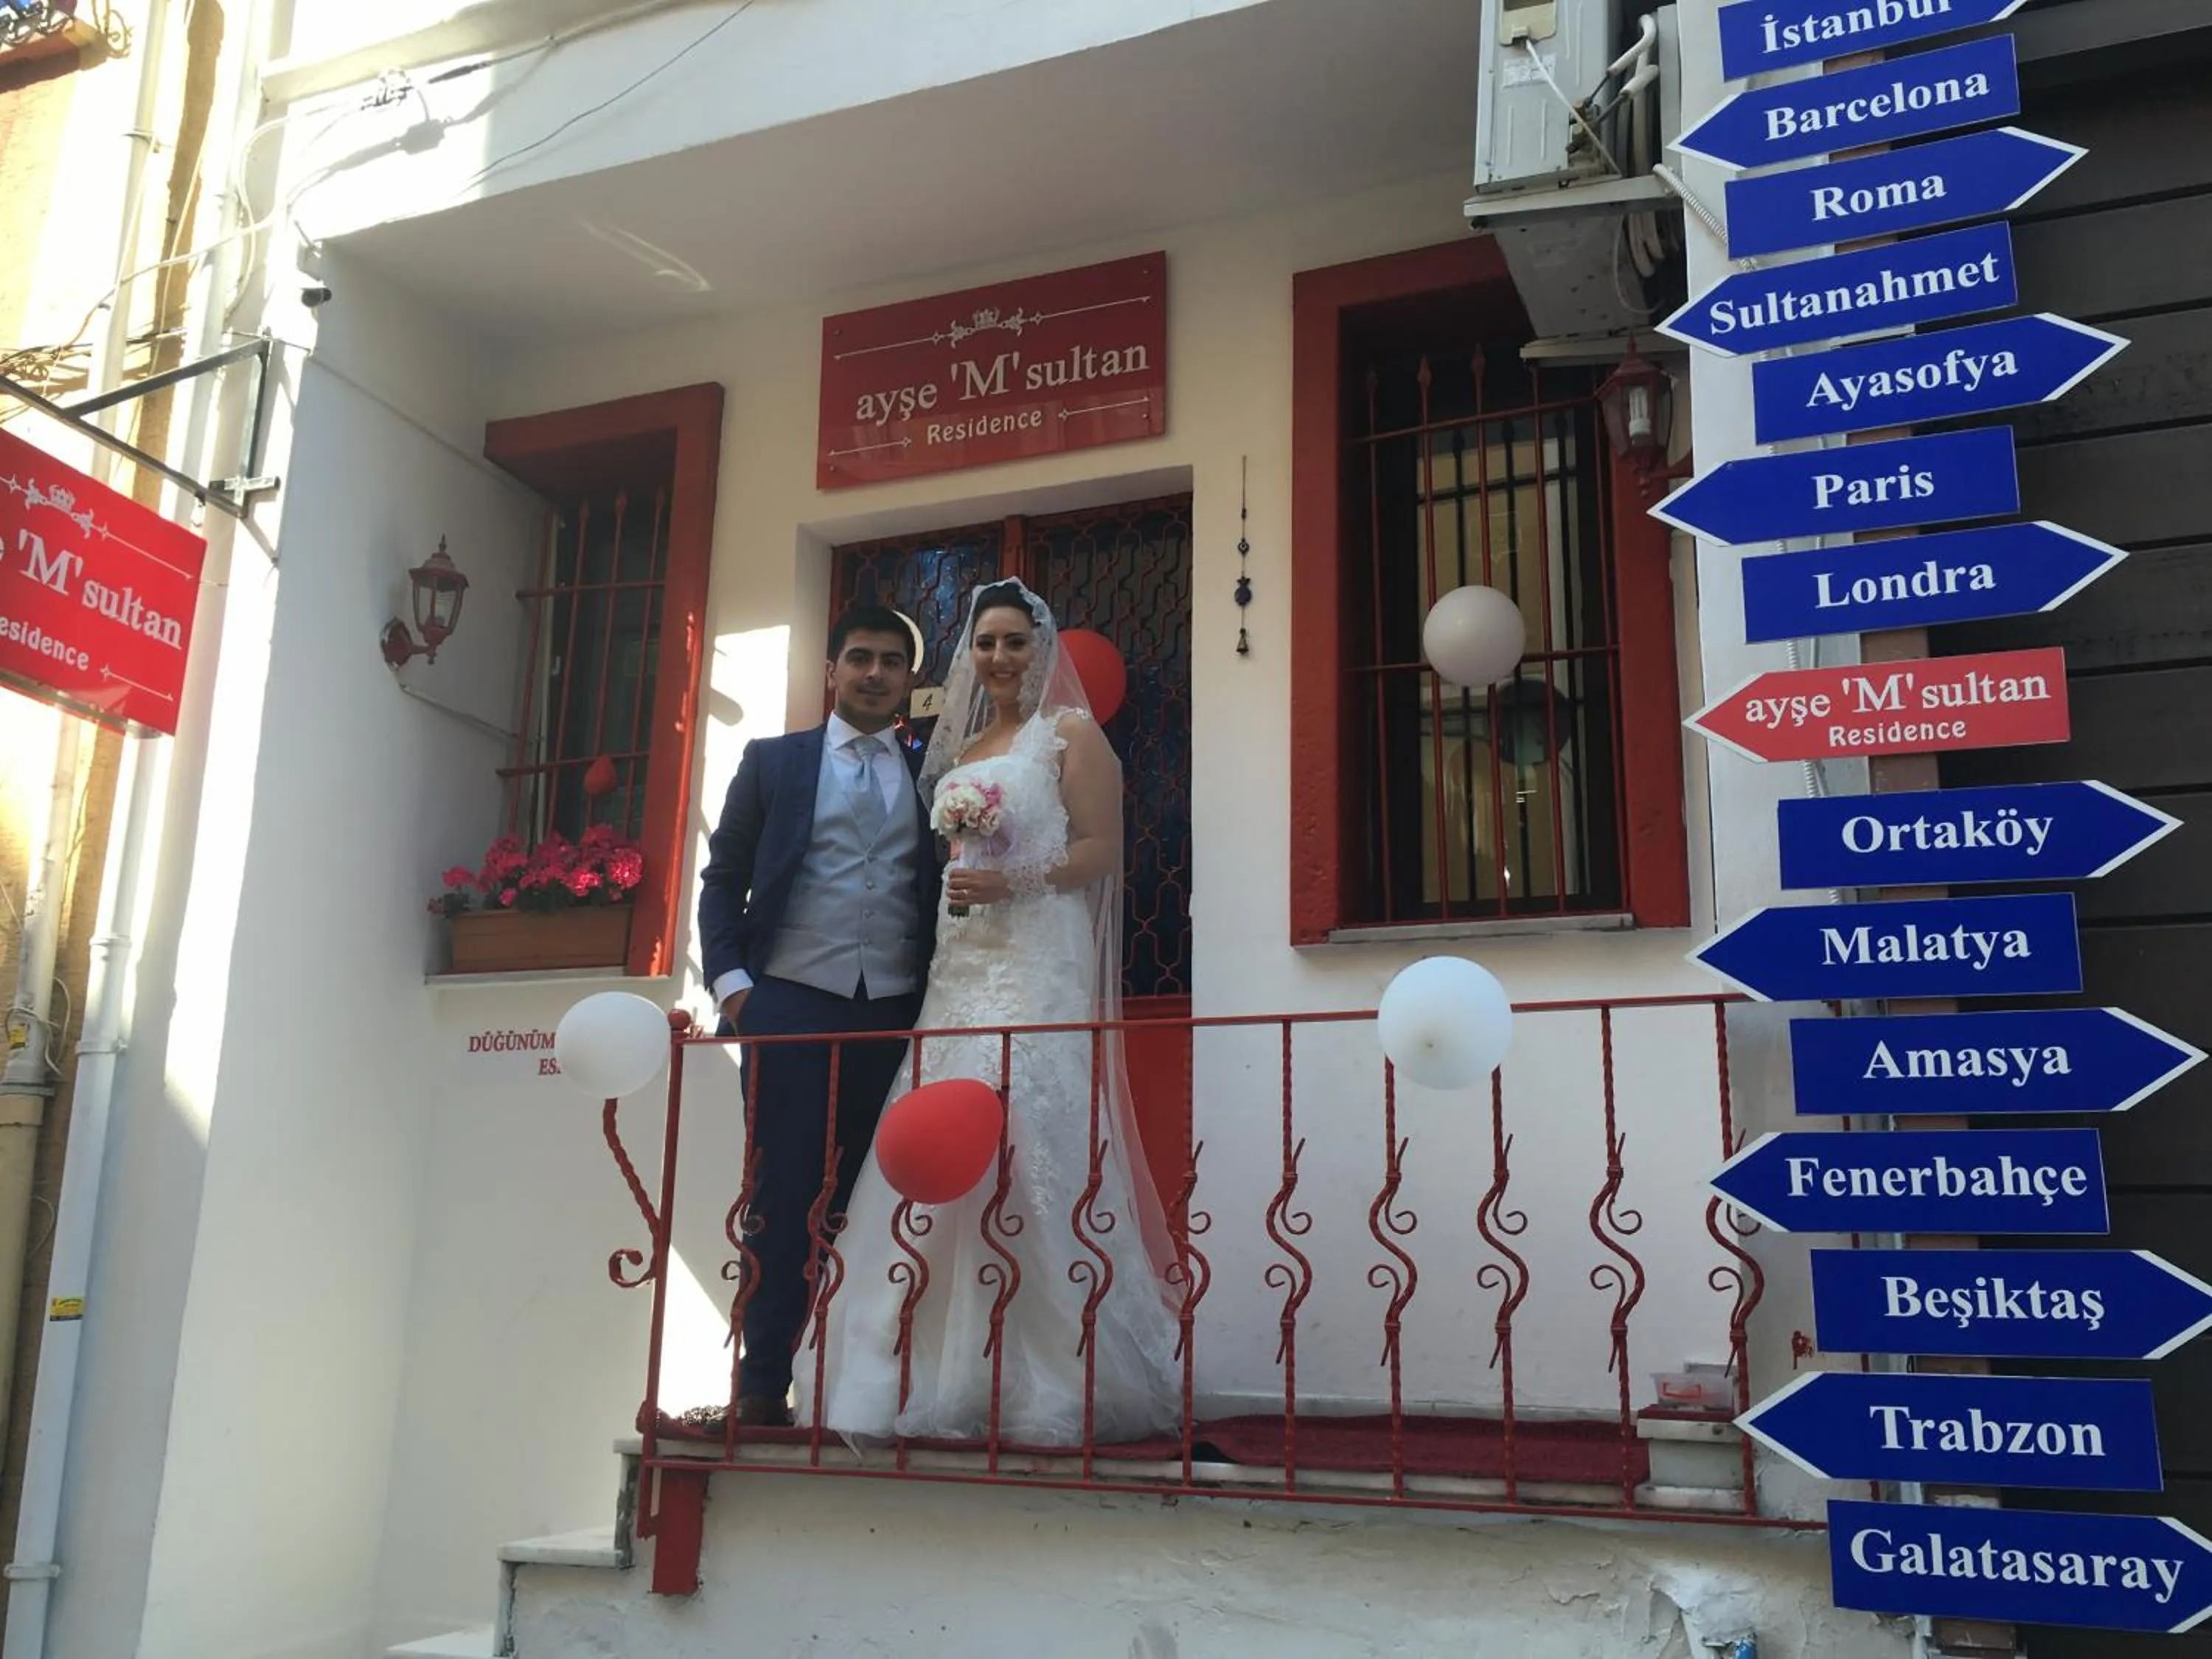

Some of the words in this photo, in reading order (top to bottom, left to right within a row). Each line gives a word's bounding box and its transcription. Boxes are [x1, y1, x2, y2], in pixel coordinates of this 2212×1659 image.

[1764, 72, 1990, 141] Barcelona
[1811, 175, 1947, 221] Roma
[1708, 252, 2000, 335] Sultanahmet
[856, 382, 938, 426] ayşe
[950, 352, 1021, 401] 'M'
[1026, 344, 1150, 392] sultan
[1806, 349, 2019, 411] Ayasofya
[927, 409, 1043, 445] Residence
[1812, 465, 1935, 509] Paris
[18, 528, 83, 596] 'M'
[81, 579, 182, 650] sultan
[1812, 560, 1996, 608] Londra
[0, 616, 89, 671] esidence
[1745, 689, 1832, 727] ayşe
[1841, 674, 1915, 714] 'M'
[1921, 672, 2051, 709] sultan
[1828, 718, 1967, 748] Residence
[1842, 808, 2053, 856] Ortaköy
[1820, 924, 2031, 970] Malatya
[467, 1029, 556, 1052] DÜĞÜNÜM
[1863, 1040, 2072, 1087] Amasya
[538, 1057, 562, 1076] ES
[1785, 1155, 2087, 1207] Fenerbahçe
[1883, 1276, 2105, 1330] Beşiktaş
[1869, 1405, 2106, 1456] Trabzon
[1850, 1528, 2184, 1603] Galatasaray
